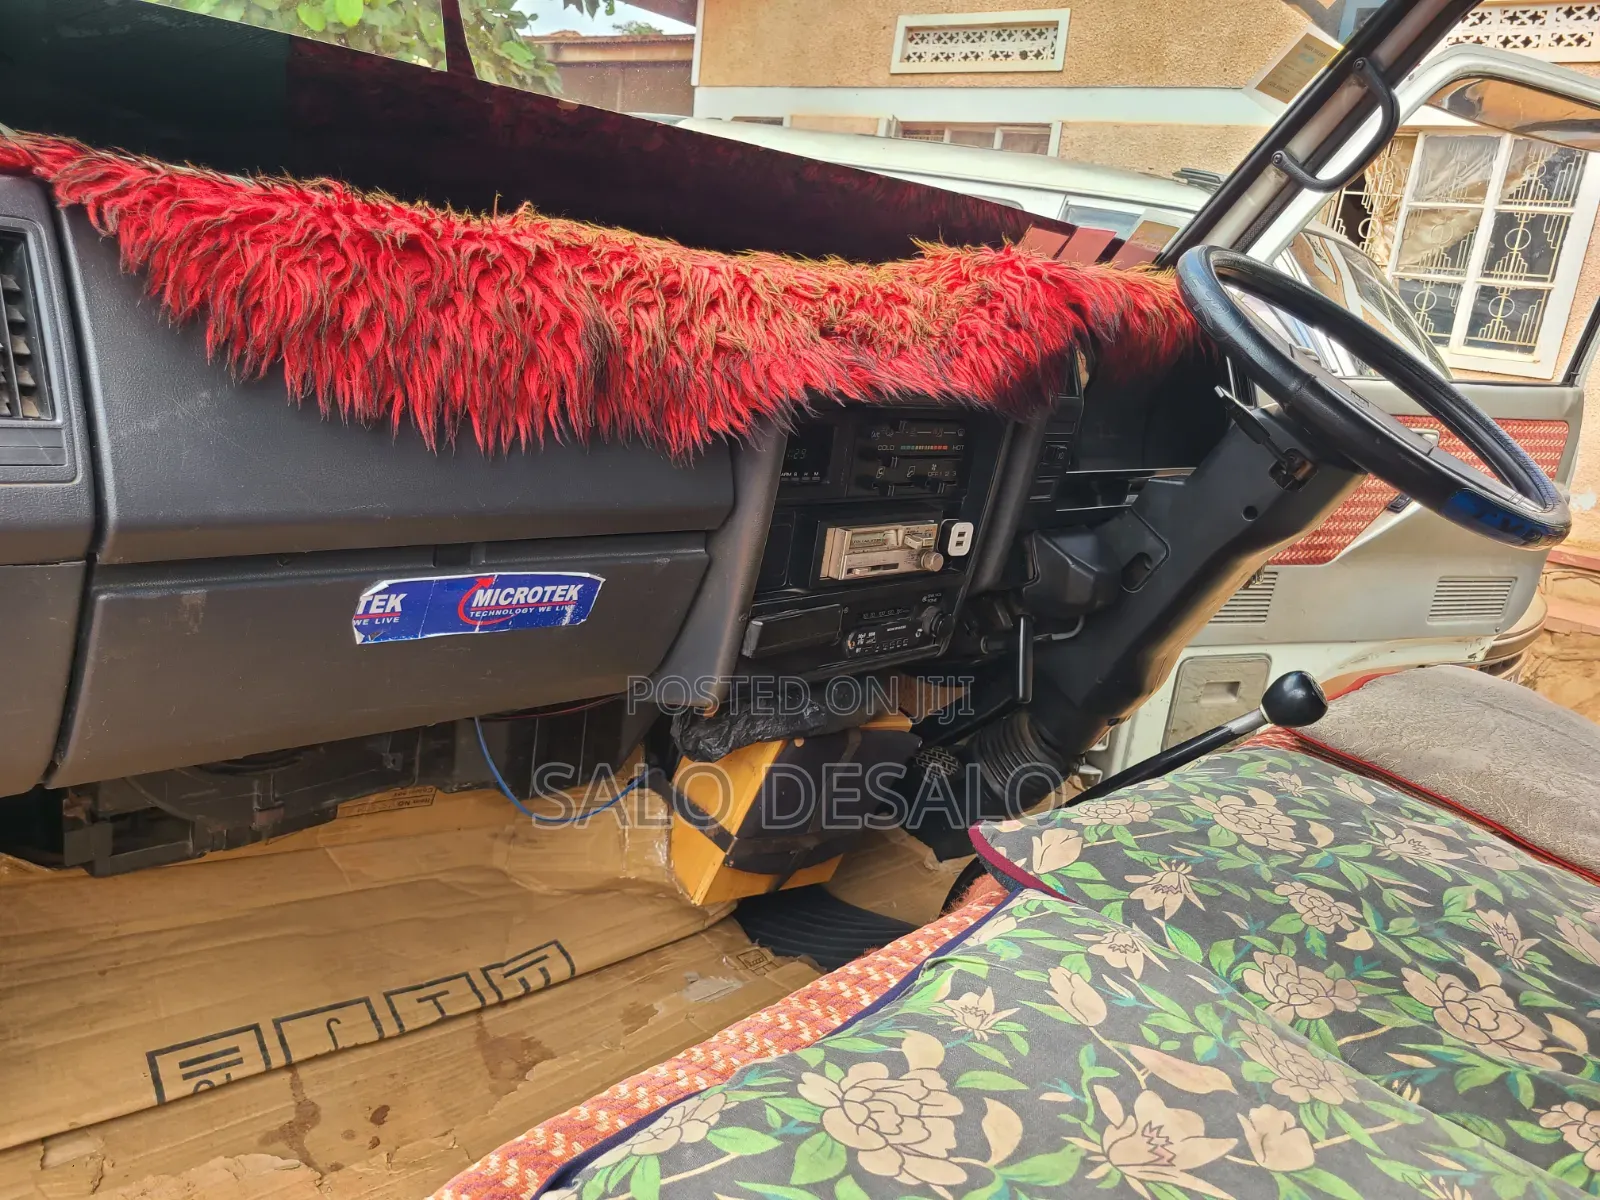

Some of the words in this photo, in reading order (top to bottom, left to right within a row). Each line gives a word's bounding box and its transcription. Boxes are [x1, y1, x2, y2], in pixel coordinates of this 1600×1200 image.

[356, 593, 408, 615] TEK
[471, 583, 584, 607] MICROTEK
[470, 607, 534, 618] TECHNOLOGY
[555, 604, 576, 612] LIVE
[375, 616, 400, 625] LIVE
